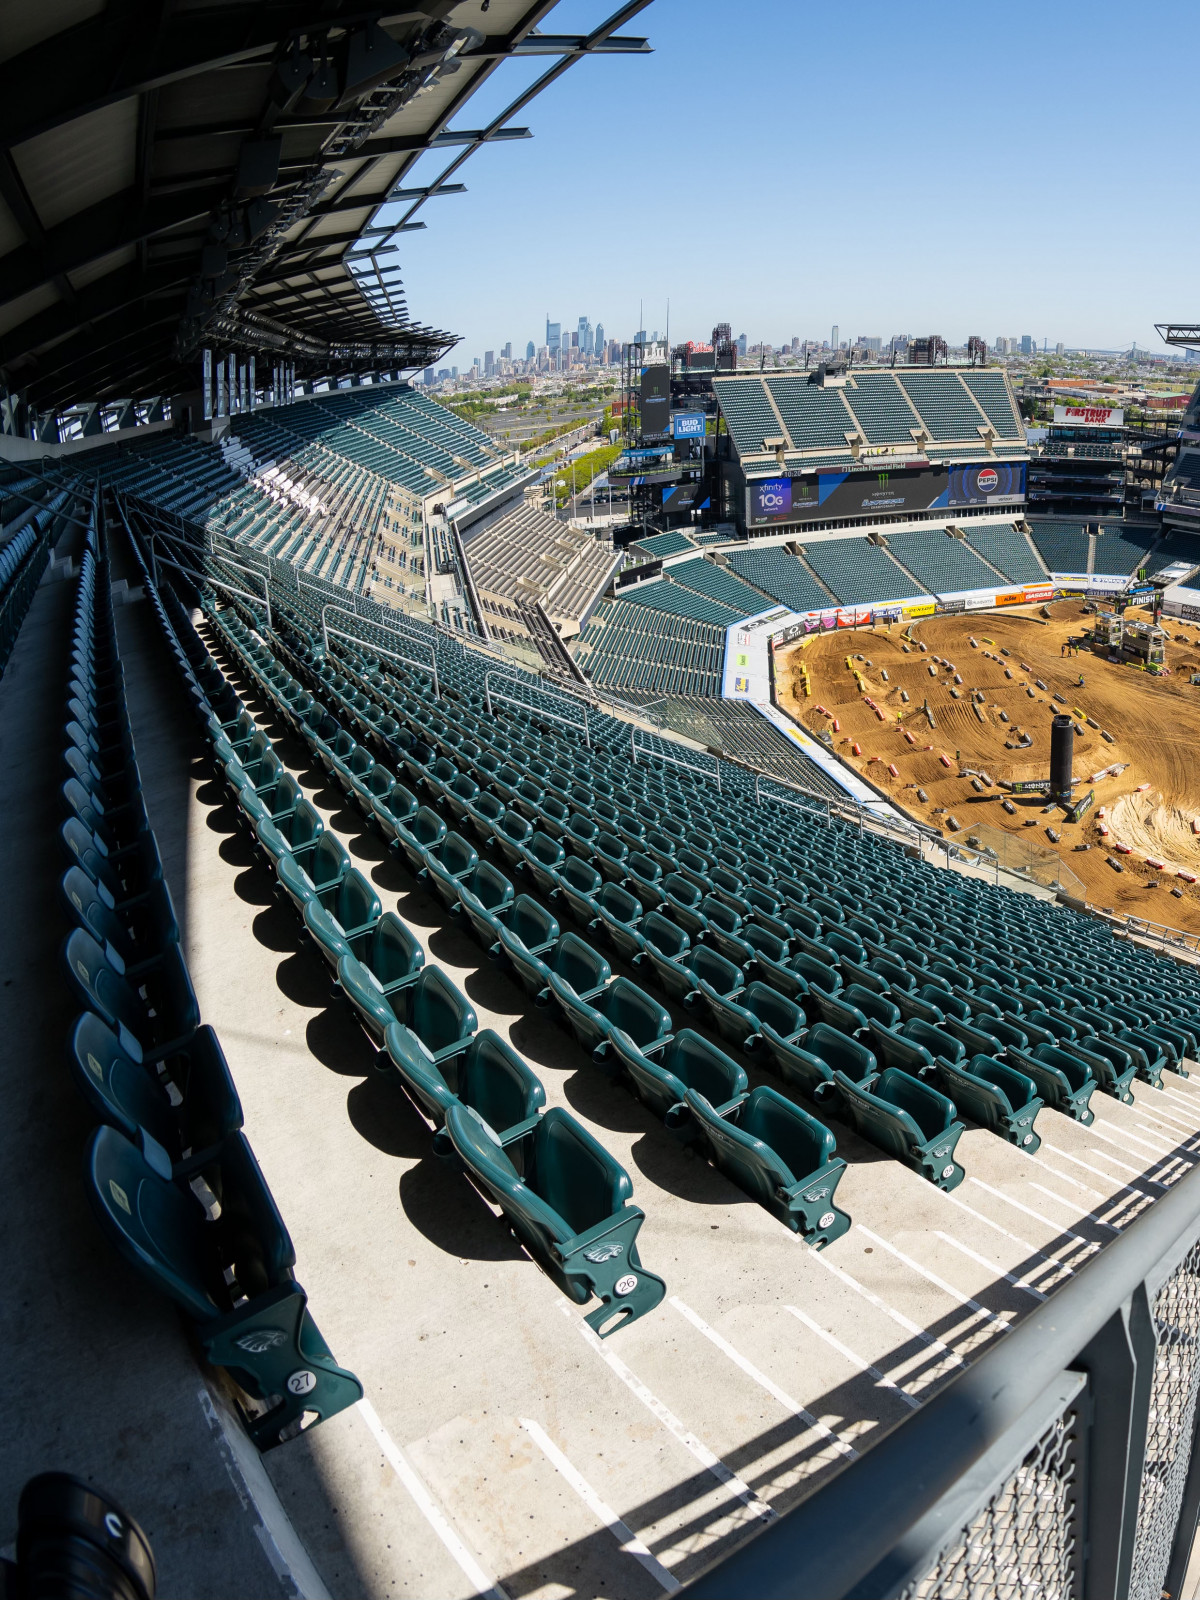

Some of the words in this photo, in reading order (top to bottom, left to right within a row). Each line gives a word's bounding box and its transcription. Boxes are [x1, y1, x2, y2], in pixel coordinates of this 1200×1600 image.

[681, 419, 698, 427] BUD
[1084, 416, 1107, 424] BANK
[678, 425, 702, 433] LIGHT
[848, 465, 868, 473] Lincoln
[868, 463, 892, 471] Financial
[893, 462, 906, 470] Field
[759, 483, 783, 493] xfinity
[759, 493, 783, 507] 10G
[1132, 594, 1156, 606] FINISH
[1024, 782, 1051, 790] MONST
[944, 1165, 954, 1177] 24
[821, 1213, 834, 1226] 25
[619, 1277, 635, 1292] 26
[291, 1372, 309, 1392] 27
